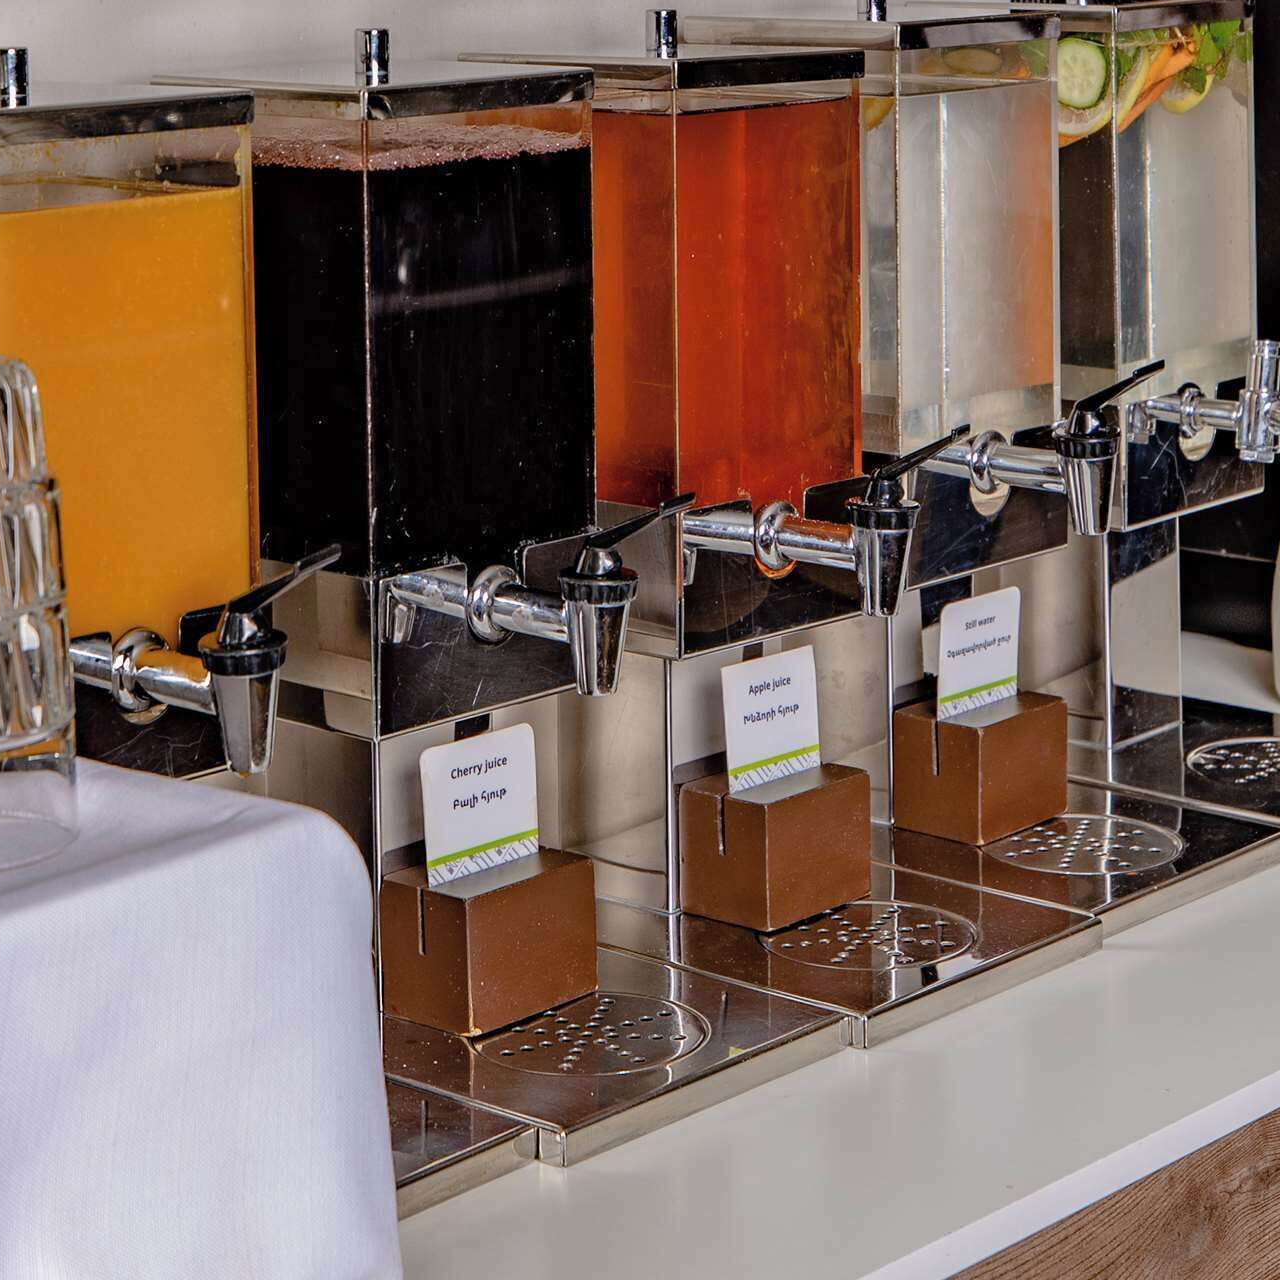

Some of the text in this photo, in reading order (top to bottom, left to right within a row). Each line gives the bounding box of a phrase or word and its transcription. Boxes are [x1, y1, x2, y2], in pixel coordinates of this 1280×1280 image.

[965, 616, 996, 631] Still water
[748, 677, 791, 696] Apple juice
[777, 703, 800, 718] հյութ
[450, 756, 508, 780] Cherry juice
[453, 787, 507, 811] Բալի հյութ
